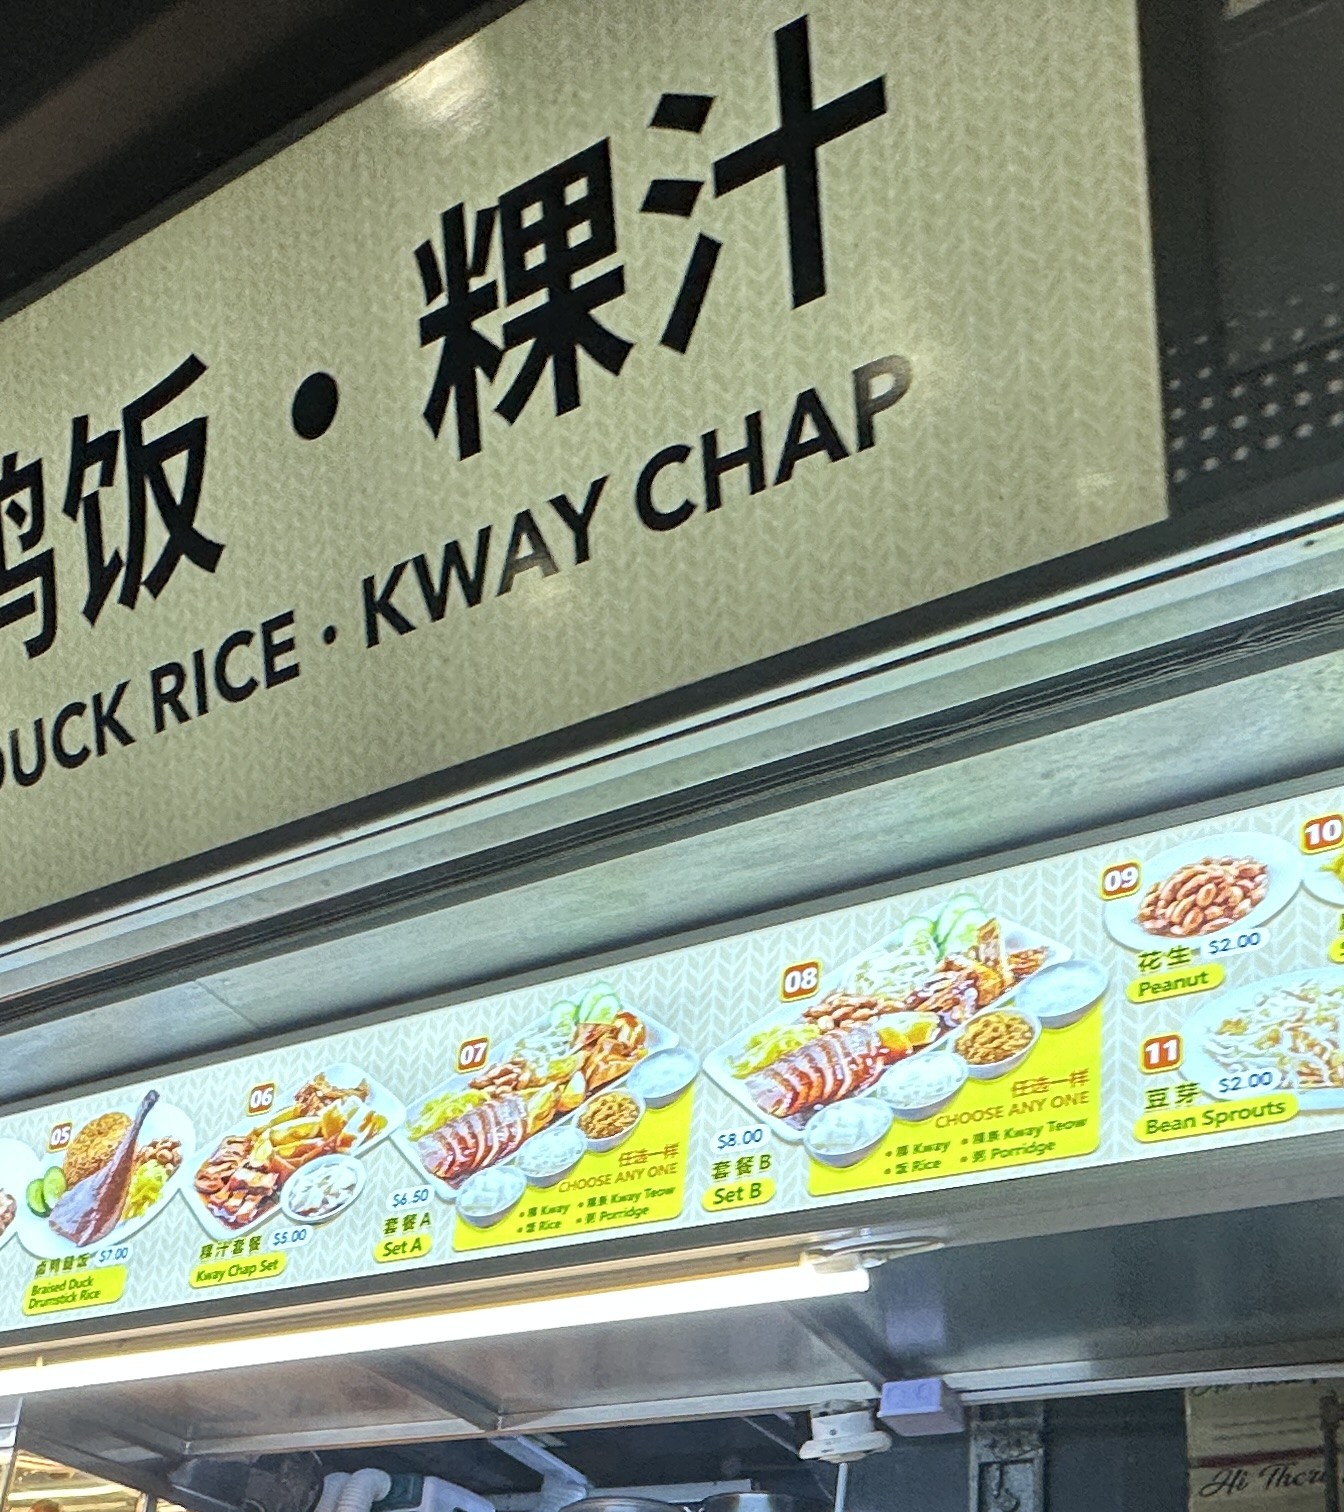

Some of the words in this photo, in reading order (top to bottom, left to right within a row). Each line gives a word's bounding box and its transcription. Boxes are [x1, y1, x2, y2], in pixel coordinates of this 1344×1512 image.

[414, 14, 887, 461] 粿汁
[149, 610, 301, 735] RICE
[362, 474, 611, 649] KWAY
[635, 354, 913, 532] CHAP
[1304, 818, 1343, 847] 10
[1103, 866, 1139, 892] 09
[1208, 931, 1262, 955] $2.00
[1137, 945, 1192, 973] 花生
[783, 967, 818, 993] 08
[1137, 970, 1210, 998] Peanut
[459, 1041, 487, 1065] 07
[1145, 1038, 1178, 1065] 11
[1218, 1071, 1274, 1093] $2.00
[249, 1087, 274, 1108] 06
[1144, 1081, 1201, 1110] 豆芽
[935, 1105, 1005, 1129] CHOOSE
[1007, 1098, 1047, 1117] ANY
[1049, 1091, 1090, 1109] ONE
[1145, 1114, 1197, 1135] Bean
[1201, 1100, 1287, 1128] Sprouts
[50, 1127, 71, 1146] 05
[1047, 1118, 1089, 1133] Teow
[717, 1128, 764, 1151] $8.00
[912, 1140, 952, 1155] Kway
[990, 1141, 1057, 1159] Porridge
[558, 1174, 613, 1194] CHOOSE
[614, 1168, 645, 1185] ANY
[647, 1162, 679, 1178] ONE
[911, 1159, 943, 1173] Rice
[392, 1188, 430, 1209] $6.50
[712, 1186, 745, 1206] Set
[748, 1182, 763, 1200] B
[538, 1219, 562, 1232] Rice
[599, 1206, 650, 1223] Porridge
[273, 1228, 307, 1246] $5.00
[382, 1241, 409, 1258] Set
[410, 1237, 423, 1253] A
[98, 1247, 129, 1263] $7.00
[196, 1269, 225, 1283] Kway
[228, 1263, 256, 1278] Chap
[259, 1258, 280, 1273] Set
[31, 1279, 67, 1297] Braised
[68, 1275, 95, 1292] Duck
[28, 1291, 78, 1310] Drumstick
[79, 1287, 101, 1302] Rice
[1198, 1466, 1249, 1498] Hi
